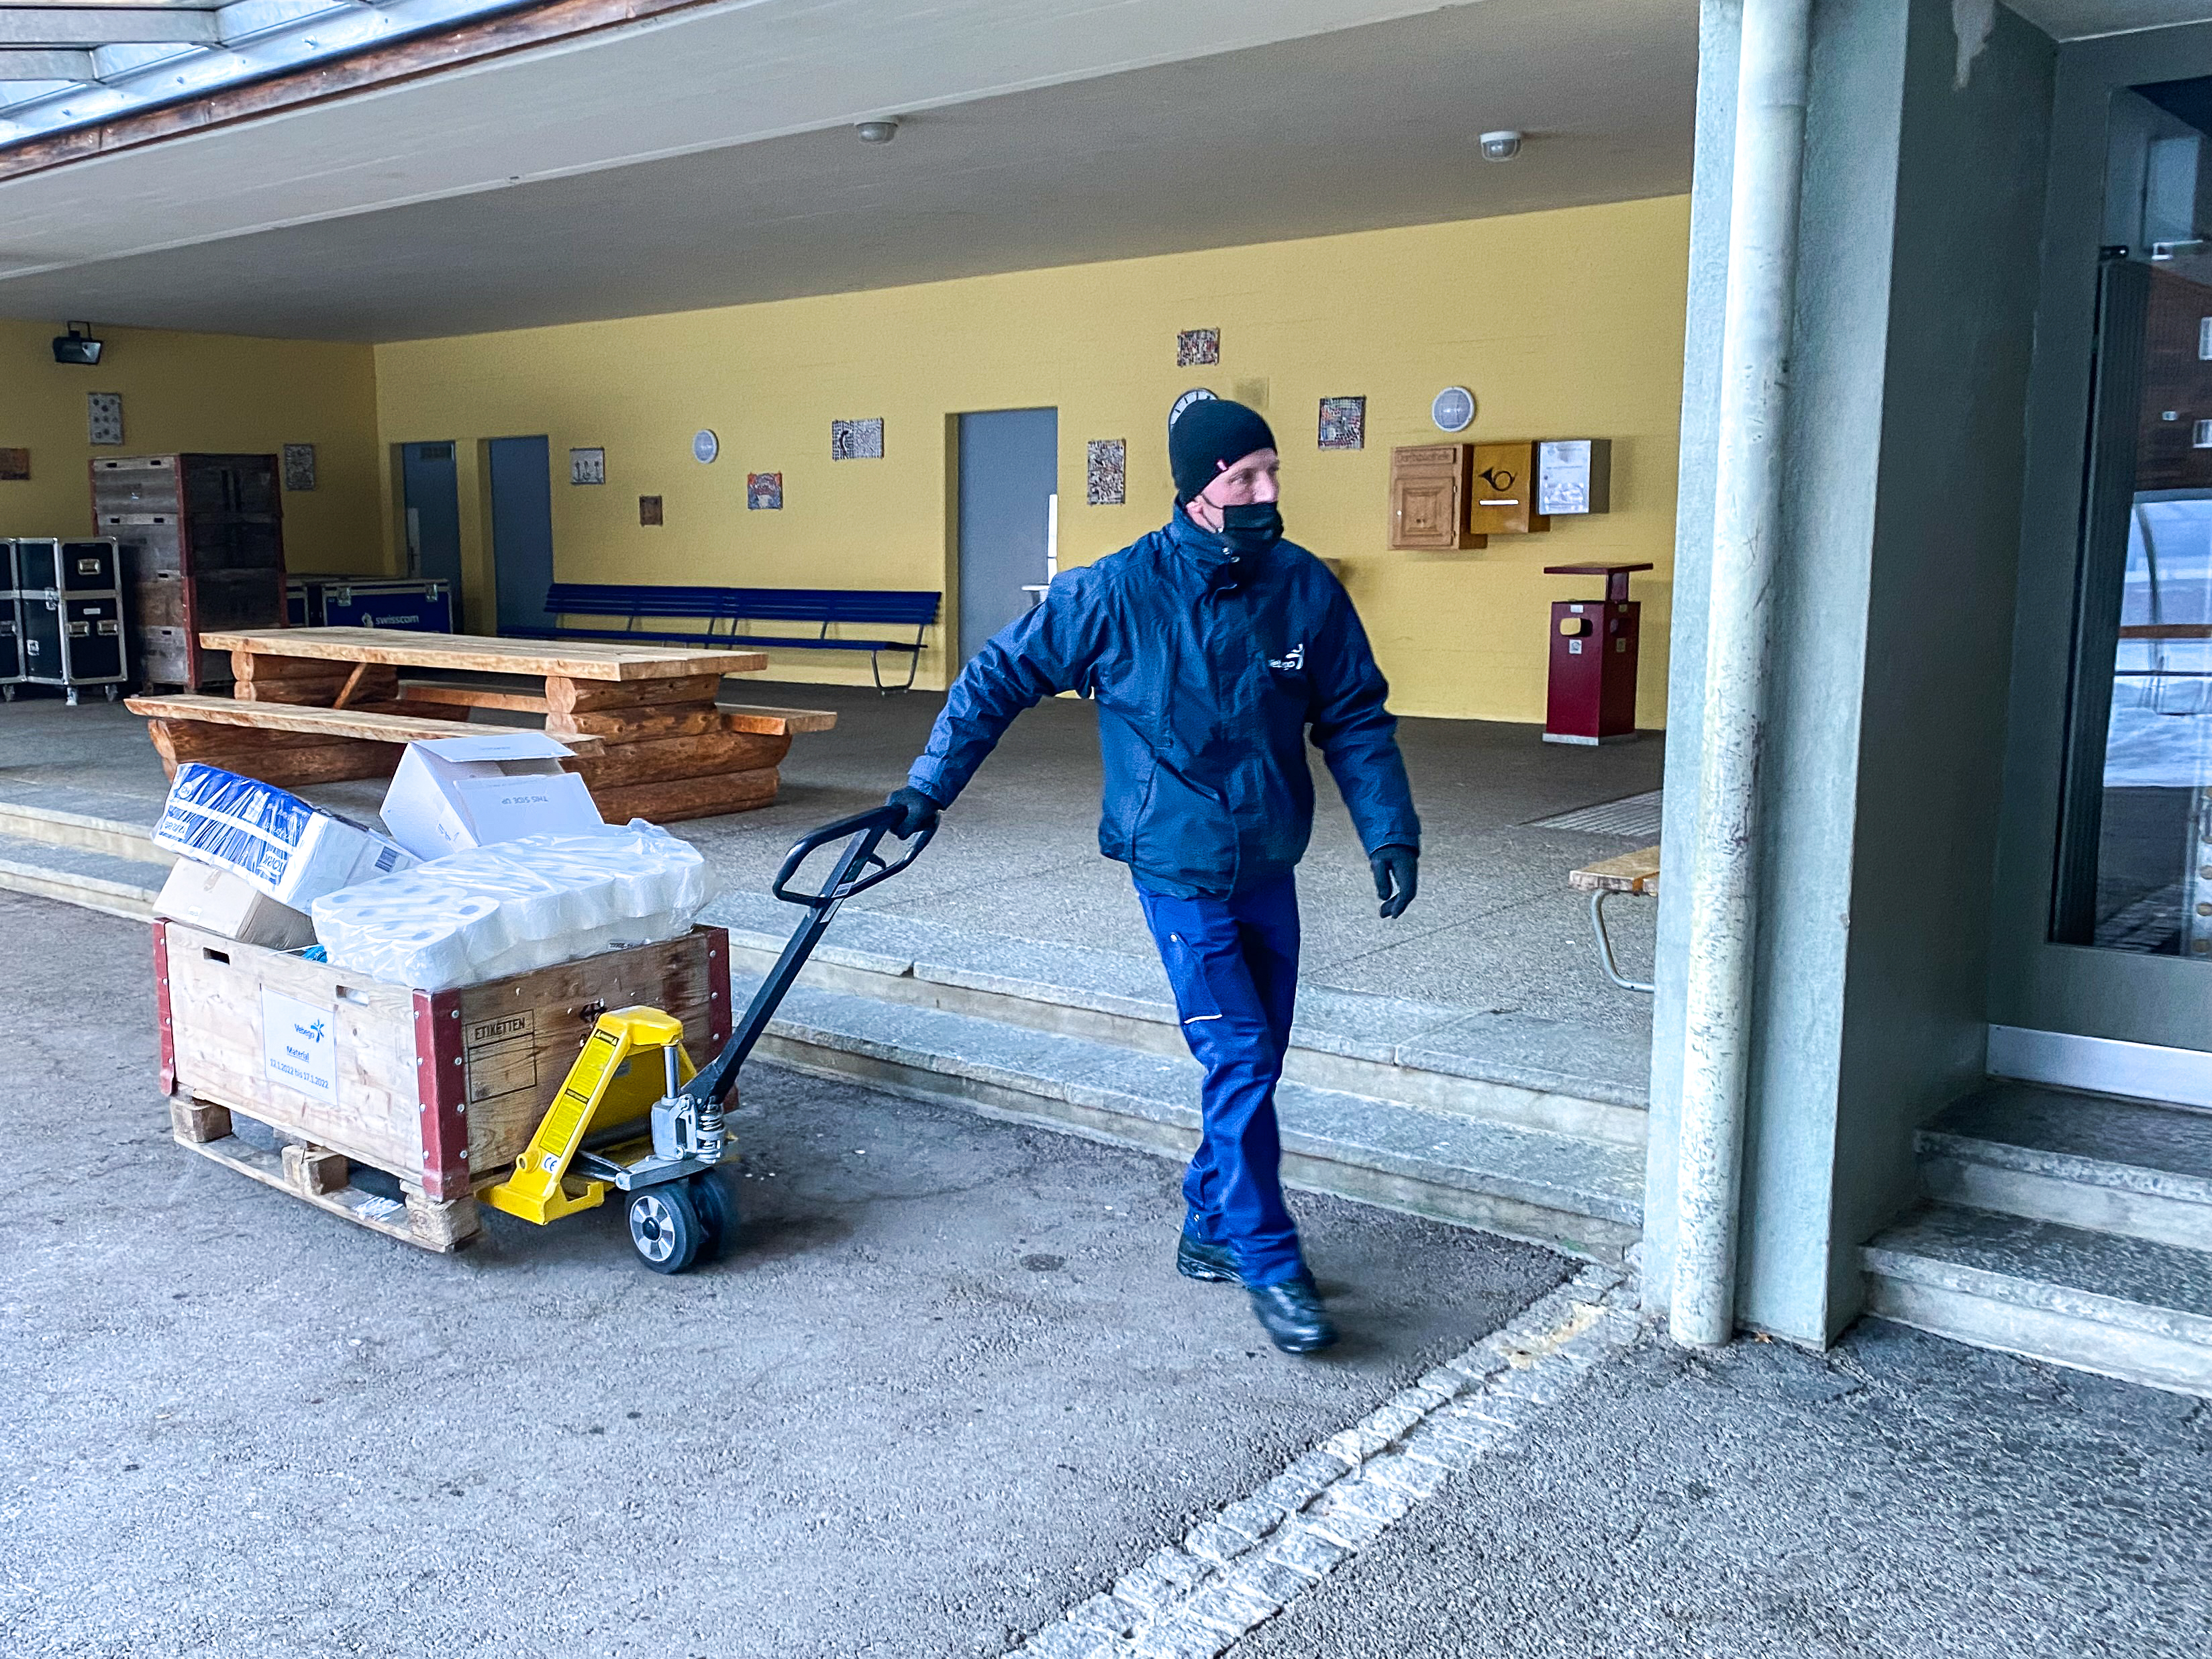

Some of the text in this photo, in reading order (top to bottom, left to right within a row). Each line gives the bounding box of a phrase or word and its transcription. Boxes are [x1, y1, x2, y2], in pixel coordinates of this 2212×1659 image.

[376, 614, 419, 625] swisscom
[531, 795, 548, 803] THIS
[262, 853, 284, 872] TORK
[294, 1023, 315, 1040] Vebego
[474, 1017, 525, 1040] ETIKETTEN
[286, 1046, 309, 1062] Material
